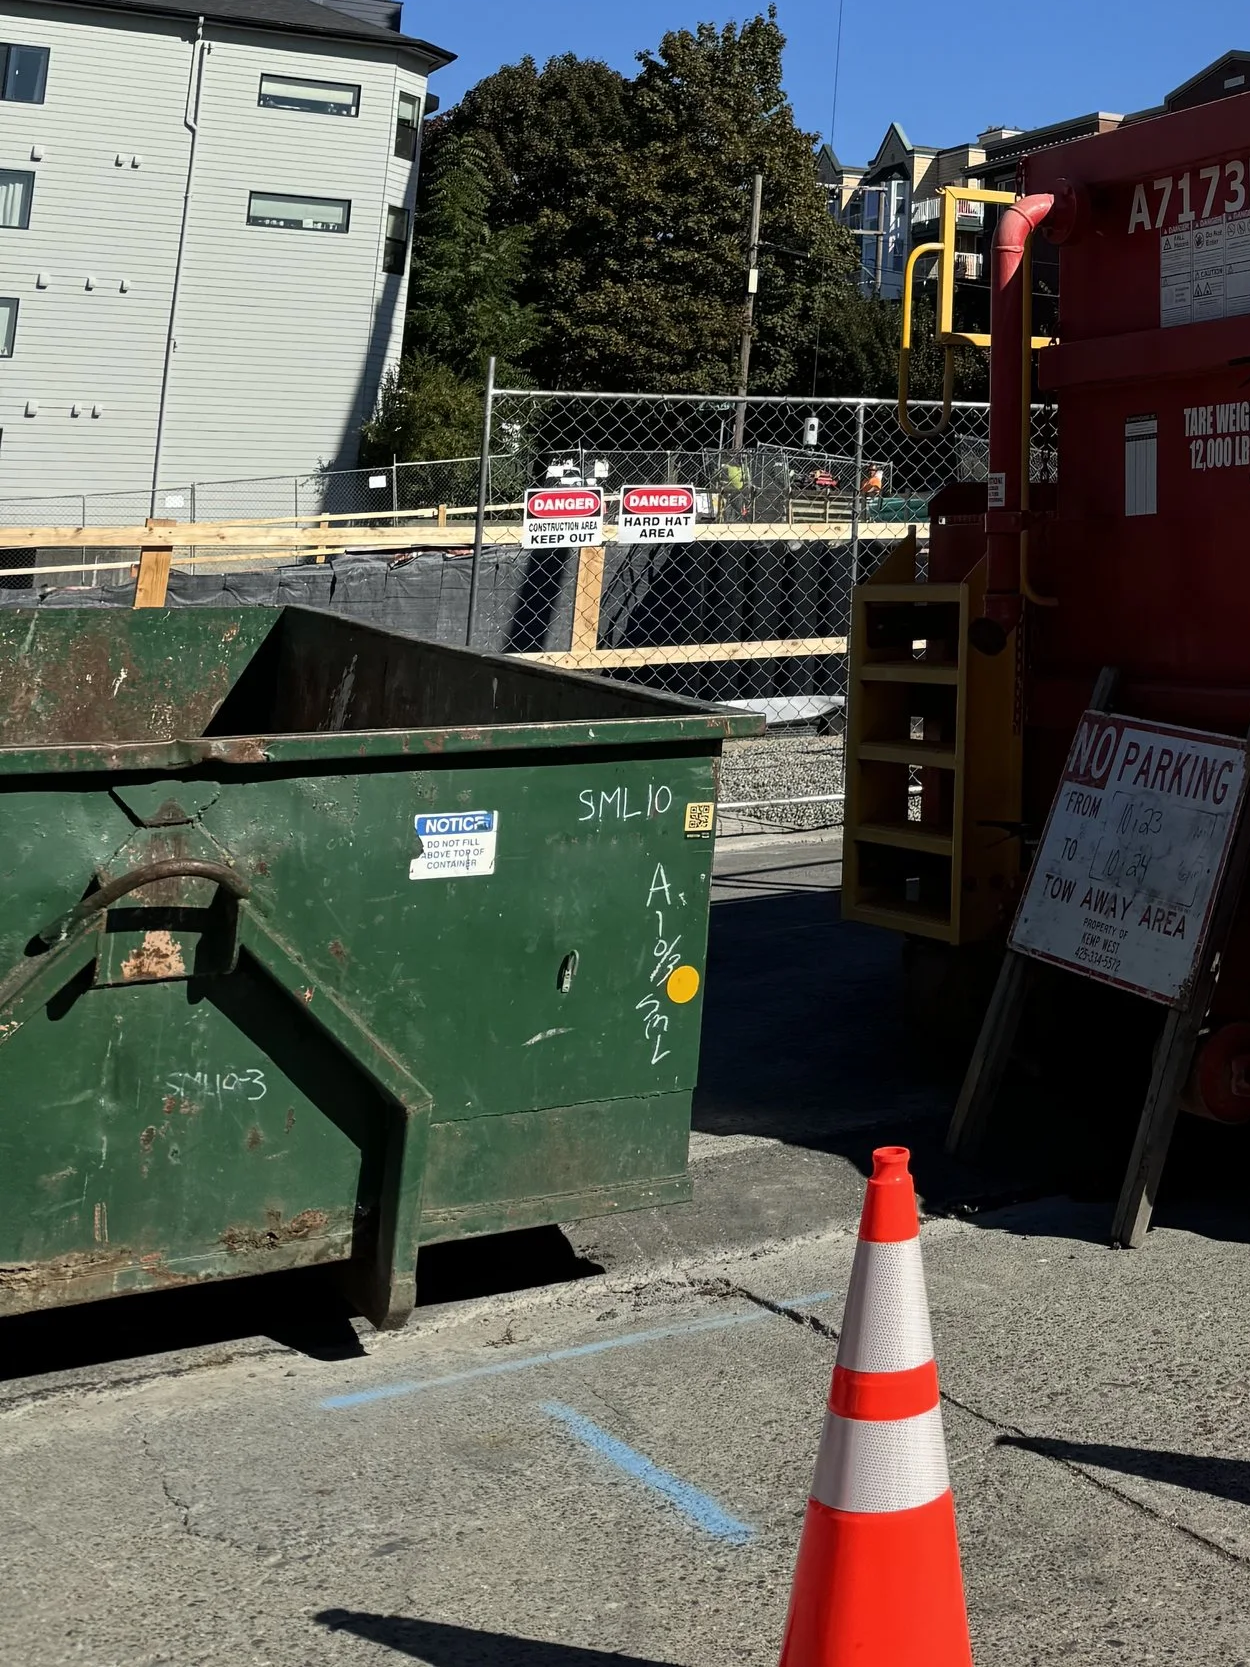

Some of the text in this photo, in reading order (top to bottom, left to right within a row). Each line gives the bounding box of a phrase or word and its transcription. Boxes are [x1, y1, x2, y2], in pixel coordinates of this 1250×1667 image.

[1183, 405, 1214, 437] TARE
[1189, 437, 1232, 472] 12,000
[534, 497, 595, 511] DANGER
[629, 495, 688, 507] DANGER
[528, 521, 598, 532] CONSTRUCTION AREA
[624, 516, 691, 527] HARD HAT
[531, 533, 595, 545] KEEP OUT
[639, 528, 675, 538] AREA
[1067, 721, 1234, 805] NO PARKING
[1065, 791, 1103, 820] FROM
[427, 838, 480, 849] DO NOT FILL
[1060, 837, 1078, 862] TO
[420, 848, 485, 859] ABOVE TOP OF
[427, 859, 477, 869] CONTAINER
[1042, 873, 1077, 904] TOW
[1080, 886, 1133, 922] AWAY
[1138, 904, 1186, 939] AREA
[1083, 918, 1129, 940] PROPERTY OF
[1081, 932, 1120, 955] KEMP WEST
